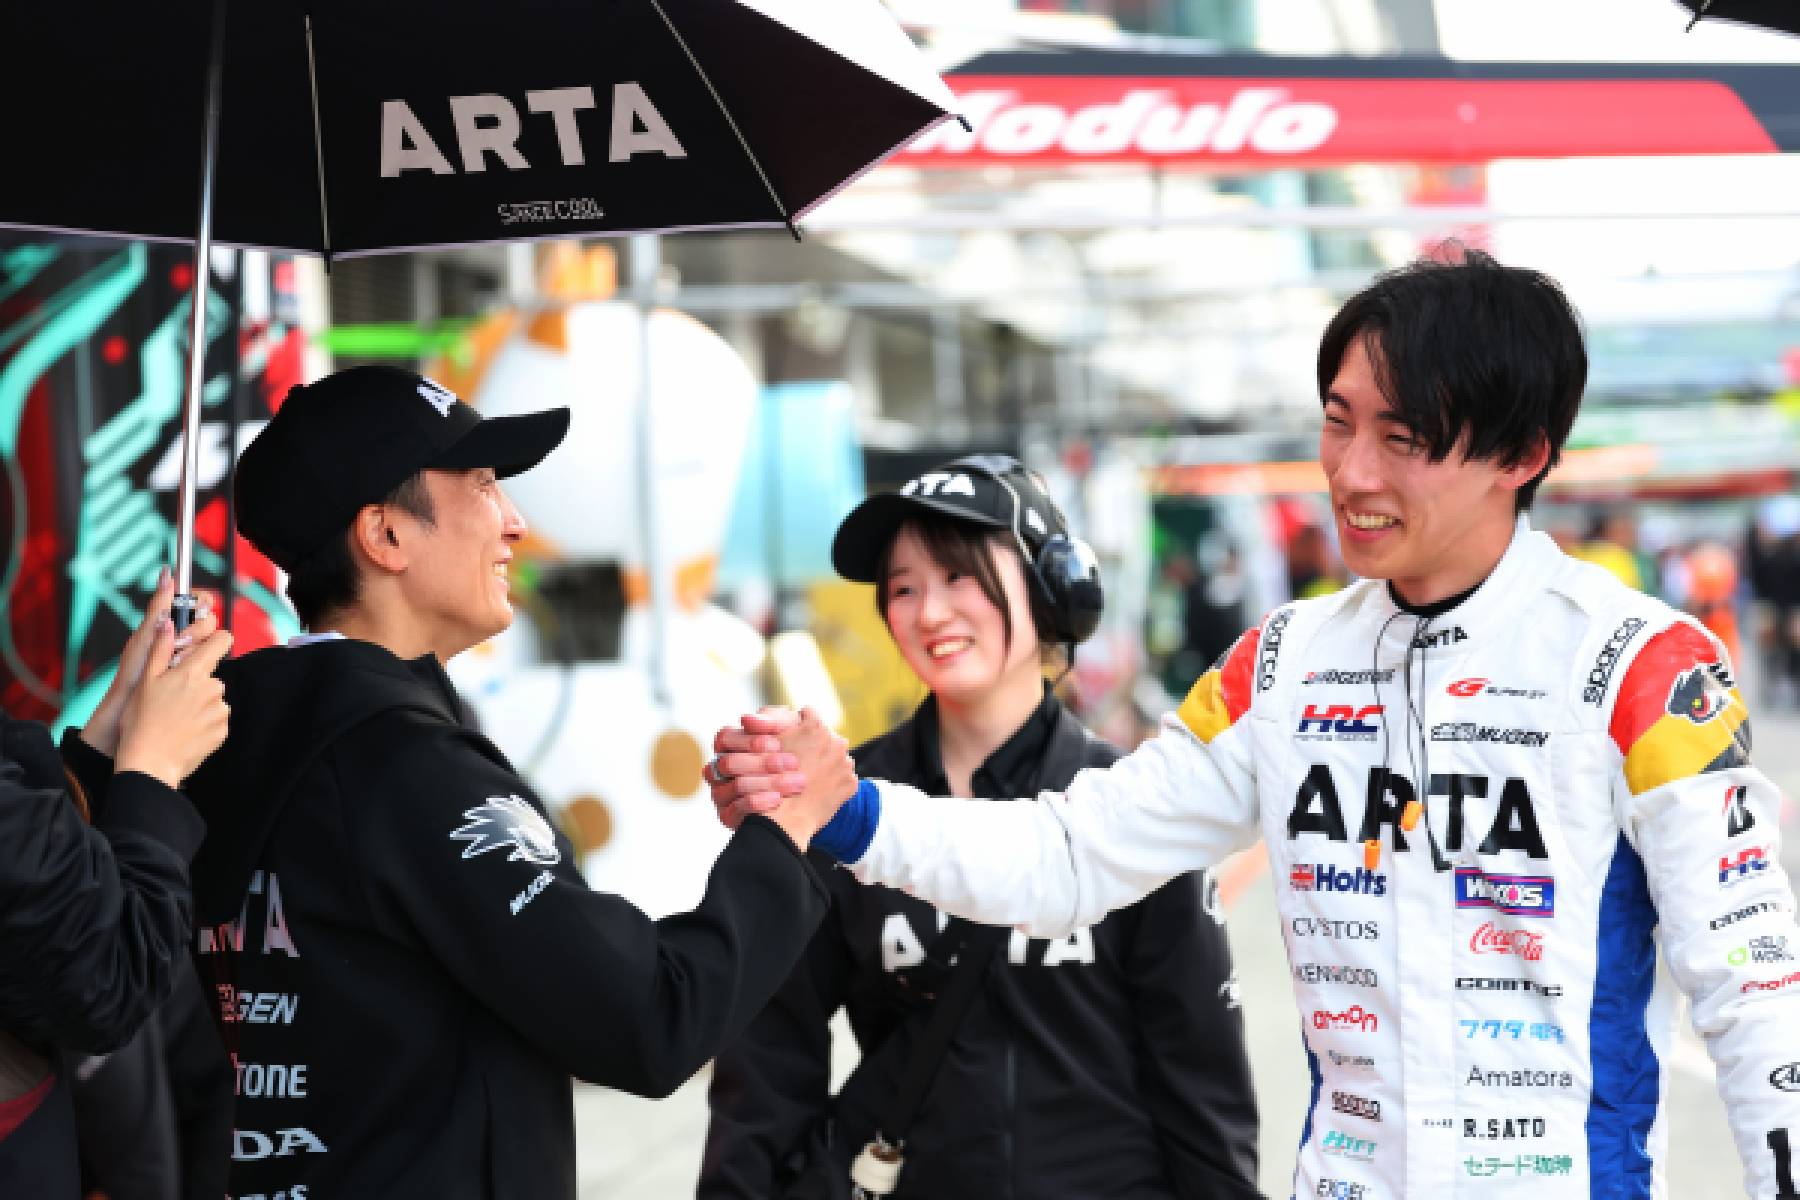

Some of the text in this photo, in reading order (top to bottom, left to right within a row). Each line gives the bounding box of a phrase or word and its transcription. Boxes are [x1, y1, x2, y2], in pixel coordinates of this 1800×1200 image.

[380, 81, 687, 178] ARTA
[1583, 617, 1648, 708] sparco
[1297, 704, 1386, 733] HRC
[1287, 764, 1549, 859] ARTA
[1316, 863, 1387, 897] Holts
[1464, 1064, 1573, 1089] Amatora
[1463, 1117, 1546, 1140] R.SATO
